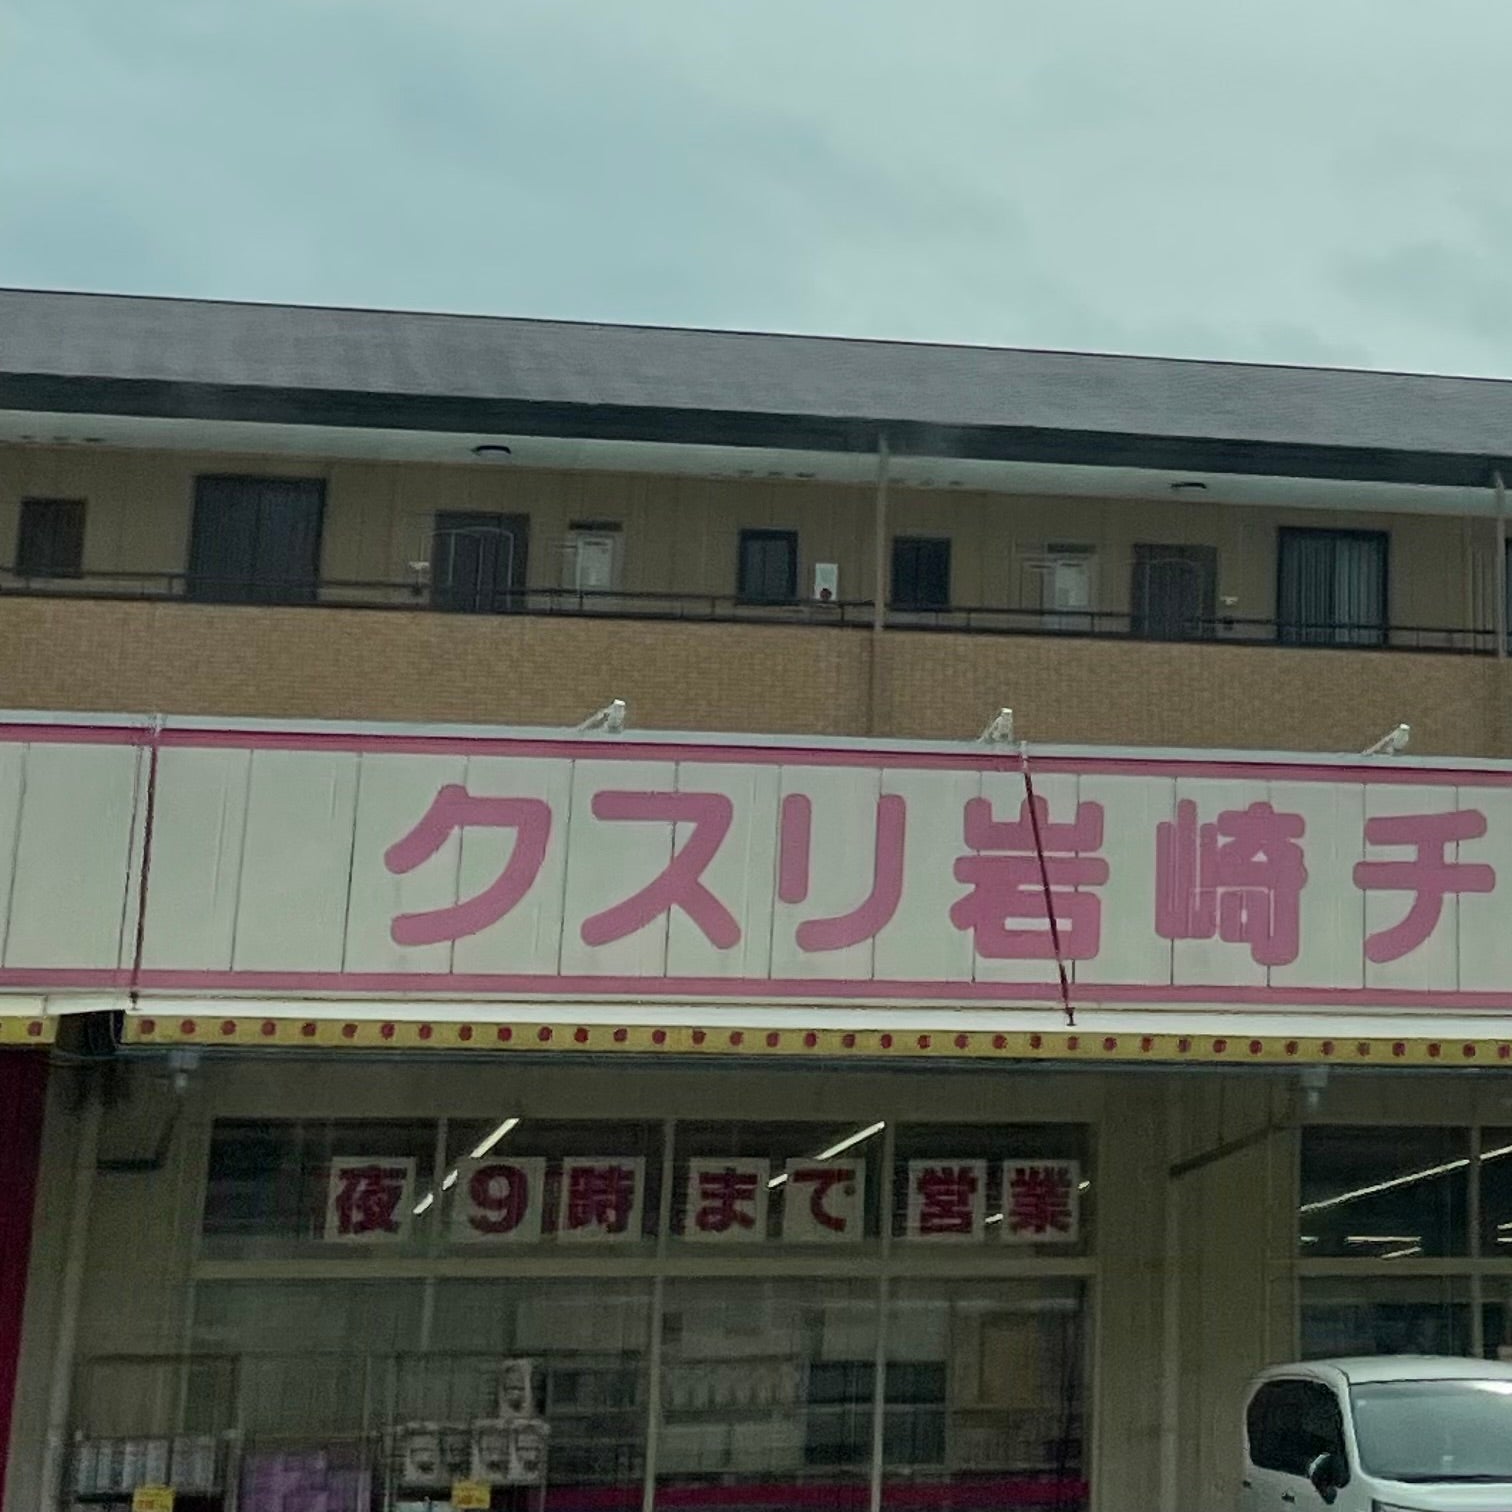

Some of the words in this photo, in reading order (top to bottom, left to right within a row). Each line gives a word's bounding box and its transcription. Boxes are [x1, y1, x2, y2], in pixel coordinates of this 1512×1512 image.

[335, 1162, 1072, 1236] 夜9時まで営業
